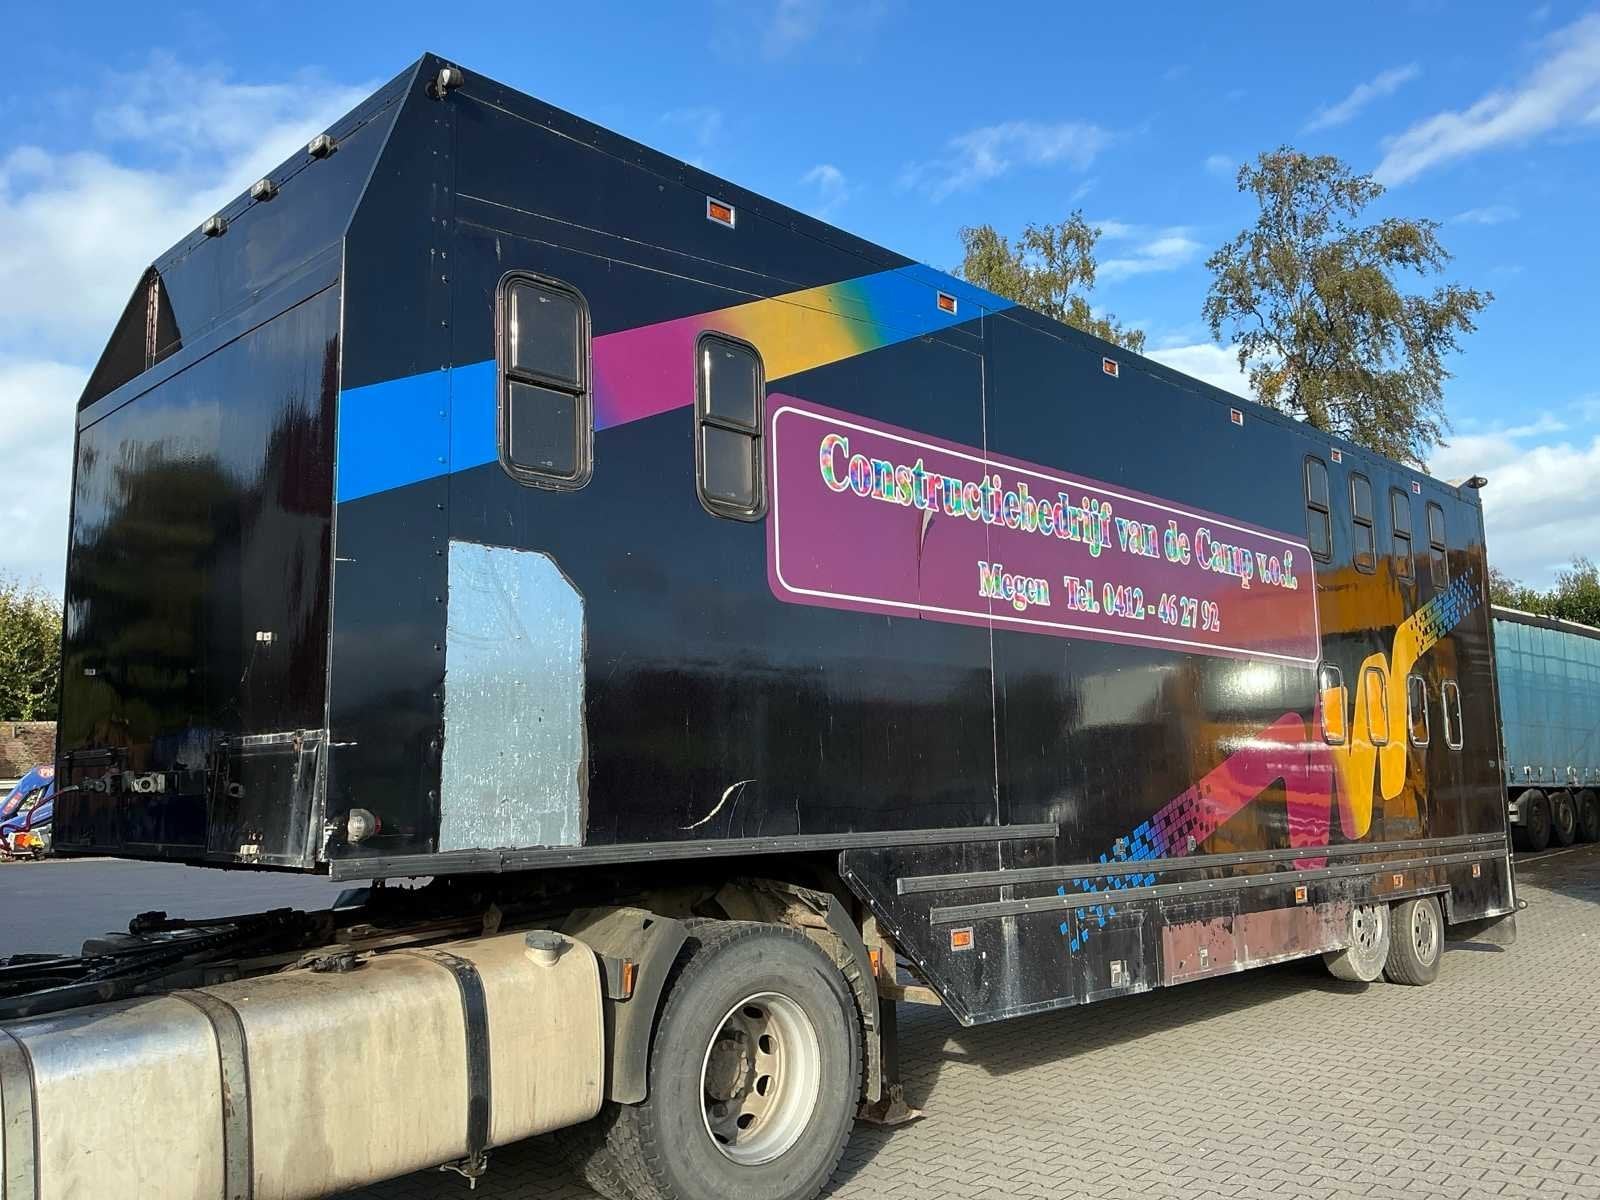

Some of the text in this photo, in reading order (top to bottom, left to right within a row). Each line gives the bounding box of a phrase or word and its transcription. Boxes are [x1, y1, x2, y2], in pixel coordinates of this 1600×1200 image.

[820, 433, 1297, 590] Constructiebedrijf van de Camp v.o.f.
[978, 561, 1050, 610] Megen
[1064, 576, 1100, 613] Tel.
[1103, 583, 1145, 619] 0412
[1158, 593, 1178, 626] 46
[1180, 596, 1198, 628] 27
[1201, 600, 1221, 632] 92
